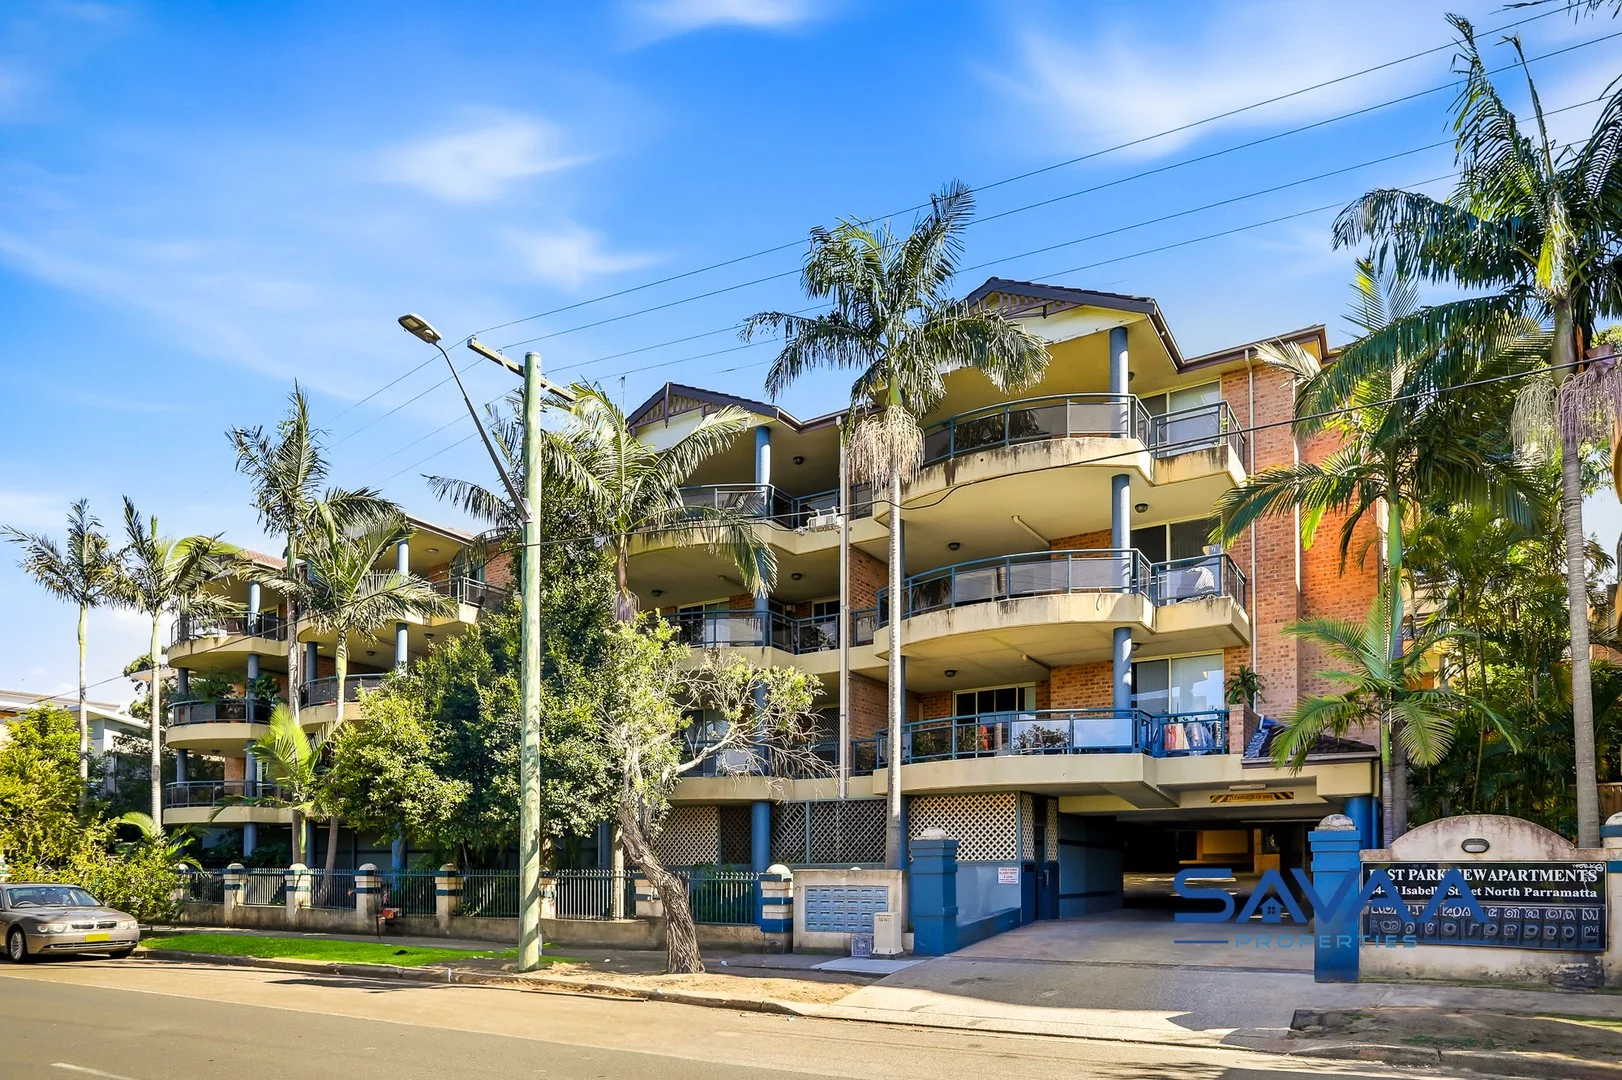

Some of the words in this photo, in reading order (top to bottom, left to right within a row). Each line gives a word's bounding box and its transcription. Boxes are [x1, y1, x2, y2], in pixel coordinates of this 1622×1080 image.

[1368, 868, 1405, 881] ST
[1408, 868, 1487, 881] PARKEW
[1488, 868, 1598, 882] APARTMENTS
[1401, 885, 1438, 895] Isabell
[1447, 886, 1482, 896] Stet
[1485, 886, 1520, 896] North
[1524, 887, 1597, 898] Parramatta
